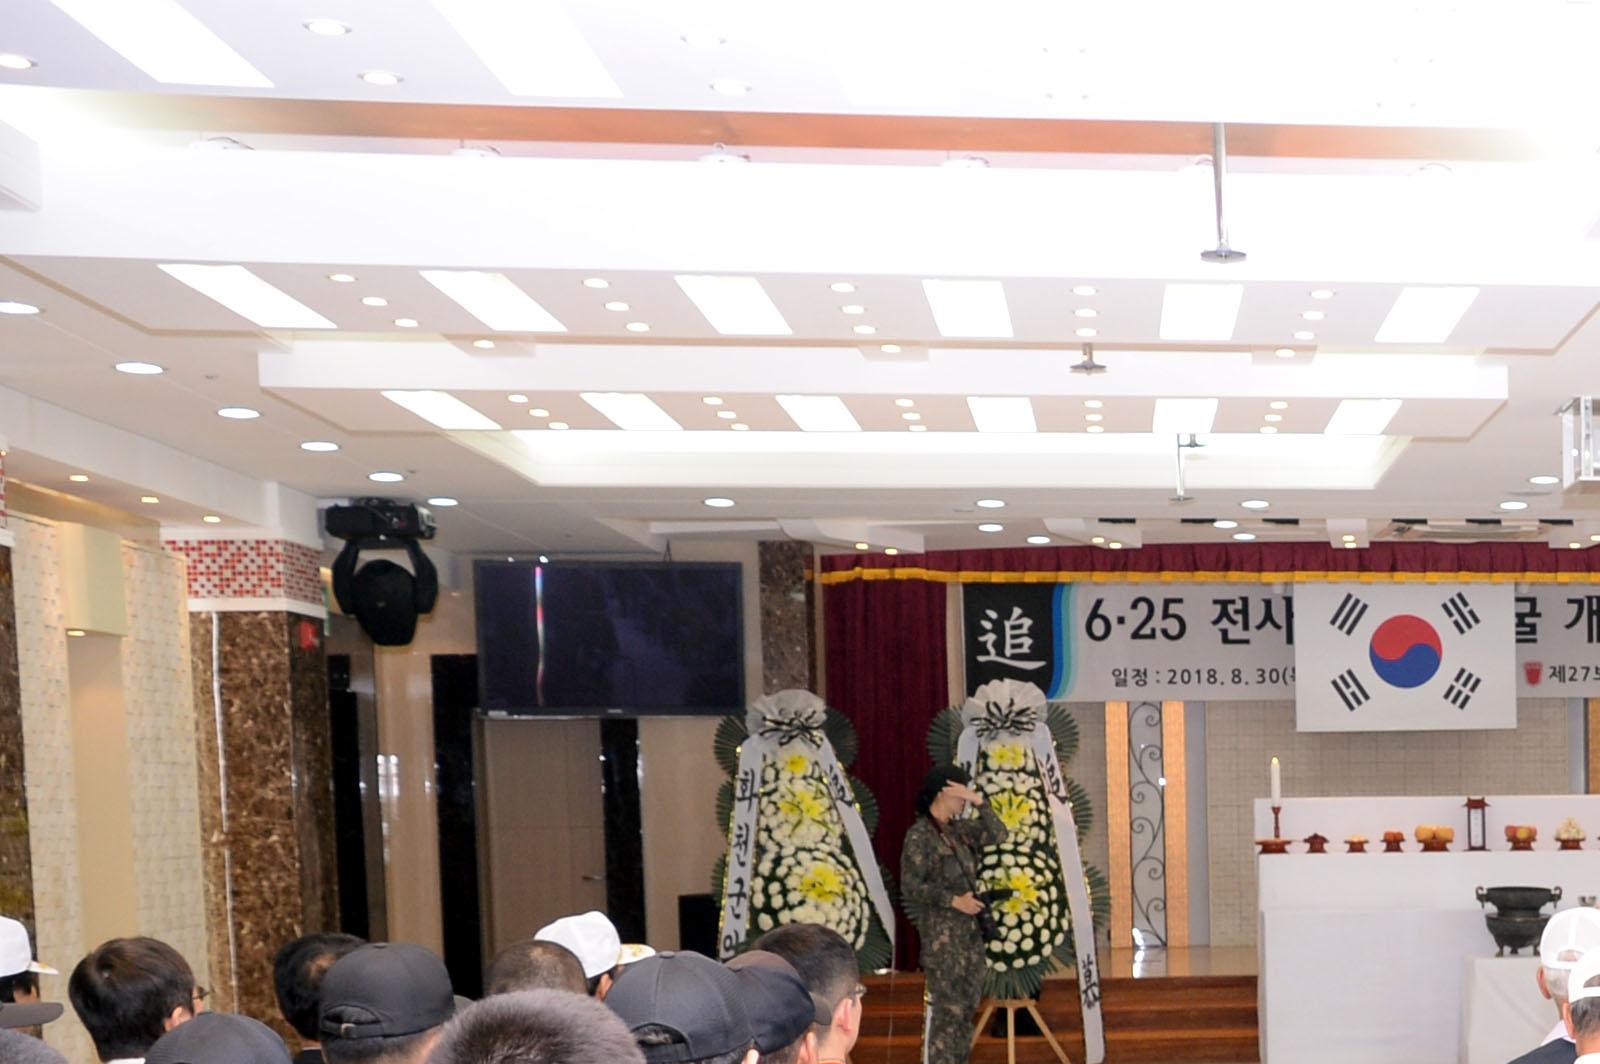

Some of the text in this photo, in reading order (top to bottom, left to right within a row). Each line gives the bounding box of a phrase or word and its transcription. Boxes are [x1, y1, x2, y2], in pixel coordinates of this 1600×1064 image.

[976, 605, 1047, 670] 追
[1210, 595, 1295, 646] 전사
[1514, 597, 1542, 644] 굴
[1111, 667, 1149, 688] 일정
